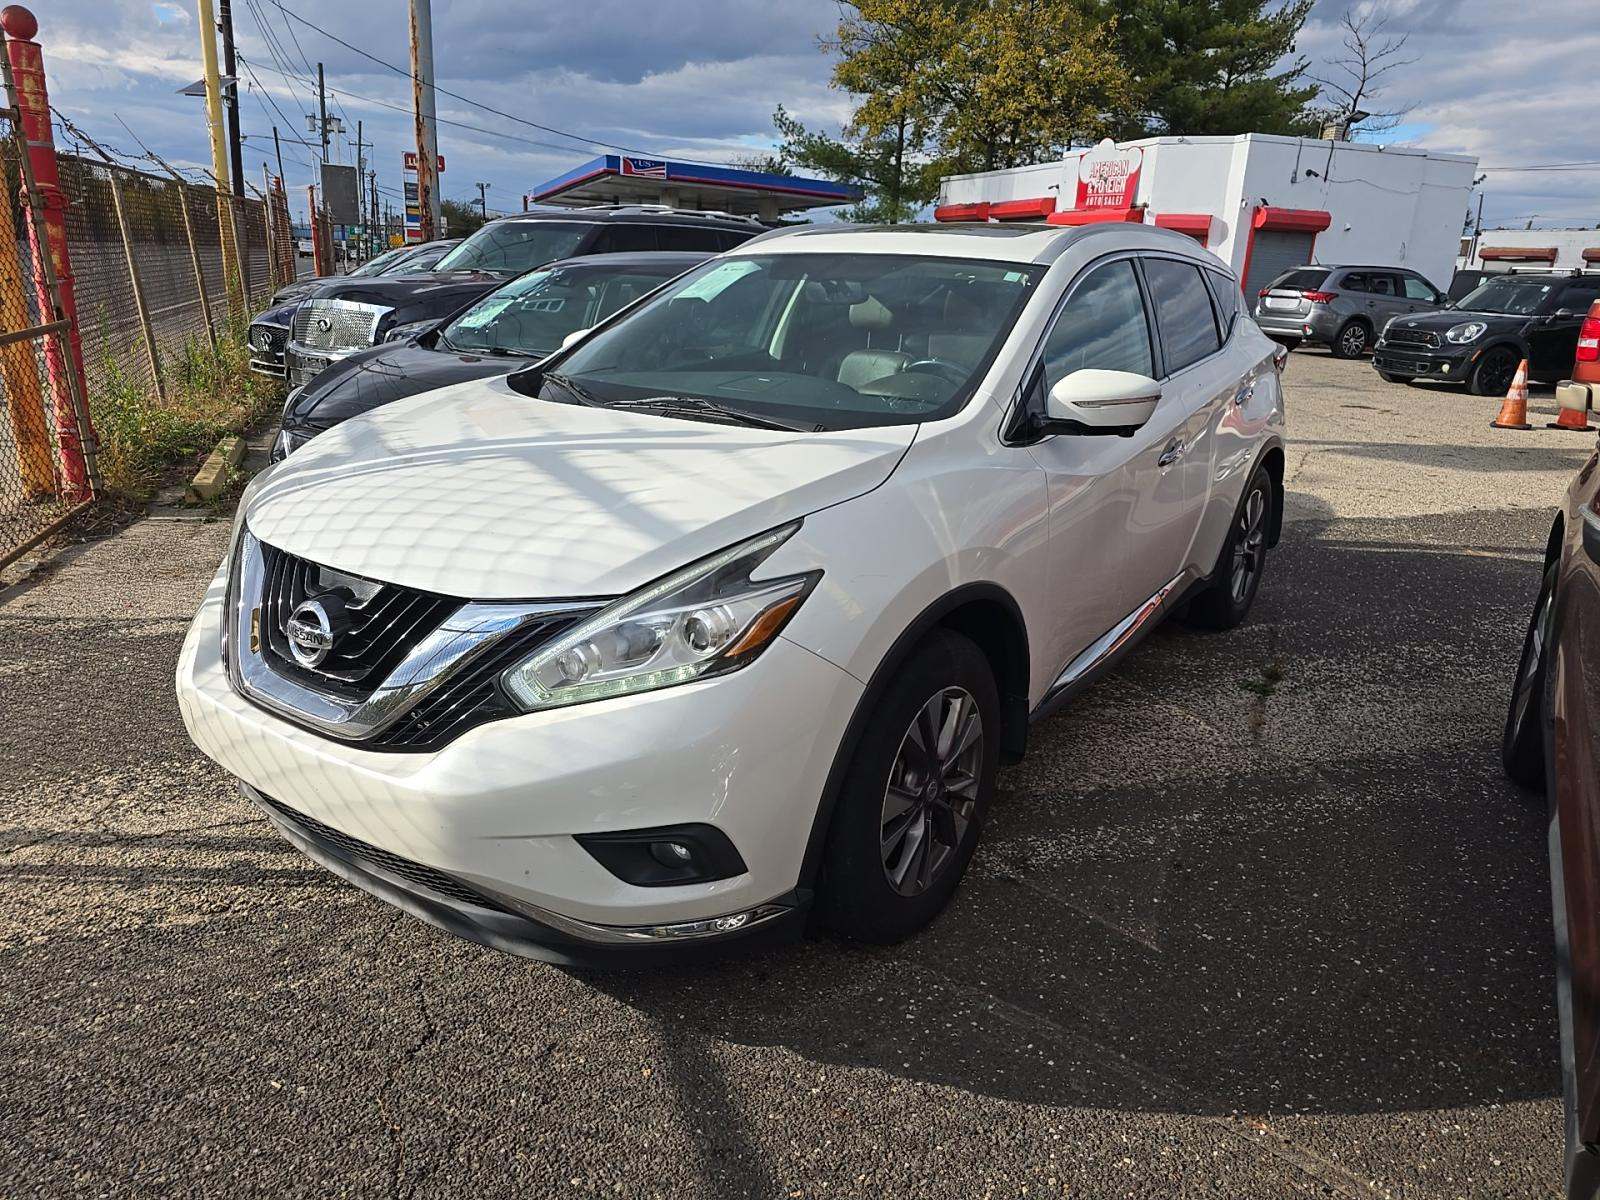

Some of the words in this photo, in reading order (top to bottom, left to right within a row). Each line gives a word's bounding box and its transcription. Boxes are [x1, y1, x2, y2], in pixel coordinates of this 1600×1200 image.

[1089, 160, 1129, 178] AMERICAN
[1087, 181, 1093, 194] &
[1086, 196, 1101, 205] AUTO
[1103, 195, 1124, 205] SALES
[290, 623, 323, 646] NISSAN
